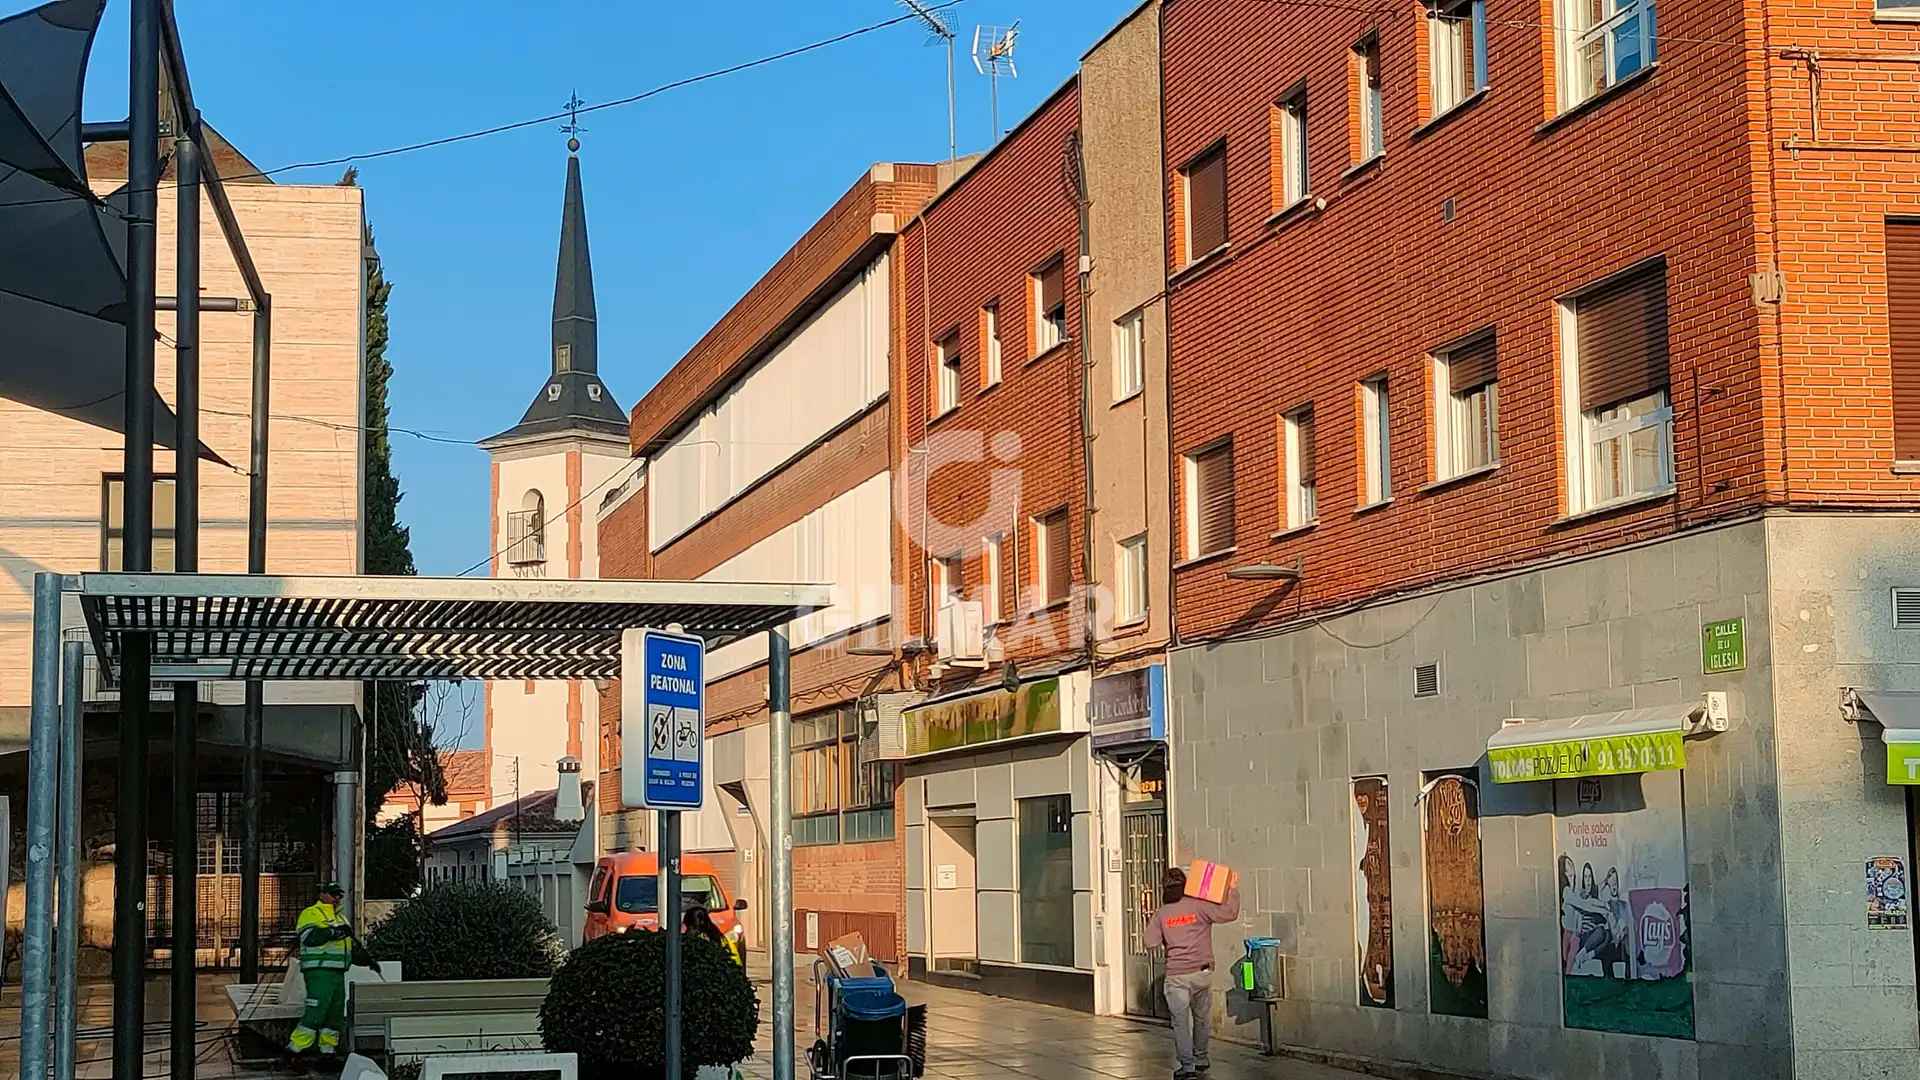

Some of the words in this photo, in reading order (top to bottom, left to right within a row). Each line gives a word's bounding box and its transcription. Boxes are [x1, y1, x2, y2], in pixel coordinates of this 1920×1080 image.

[1715, 623, 1737, 636] CALLE
[661, 653, 687, 671] ZONA
[1710, 651, 1738, 669] IGLESIA
[651, 674, 696, 695] PEATONAL
[1533, 753, 1582, 777] POZUELO
[1597, 750, 1614, 771] 91
[1658, 744, 1675, 766] 11
[1568, 821, 1590, 835] Ponle
[1591, 821, 1613, 834] sabor
[1576, 838, 1581, 848] a
[1582, 836, 1590, 848] la
[1590, 835, 1607, 847] vida
